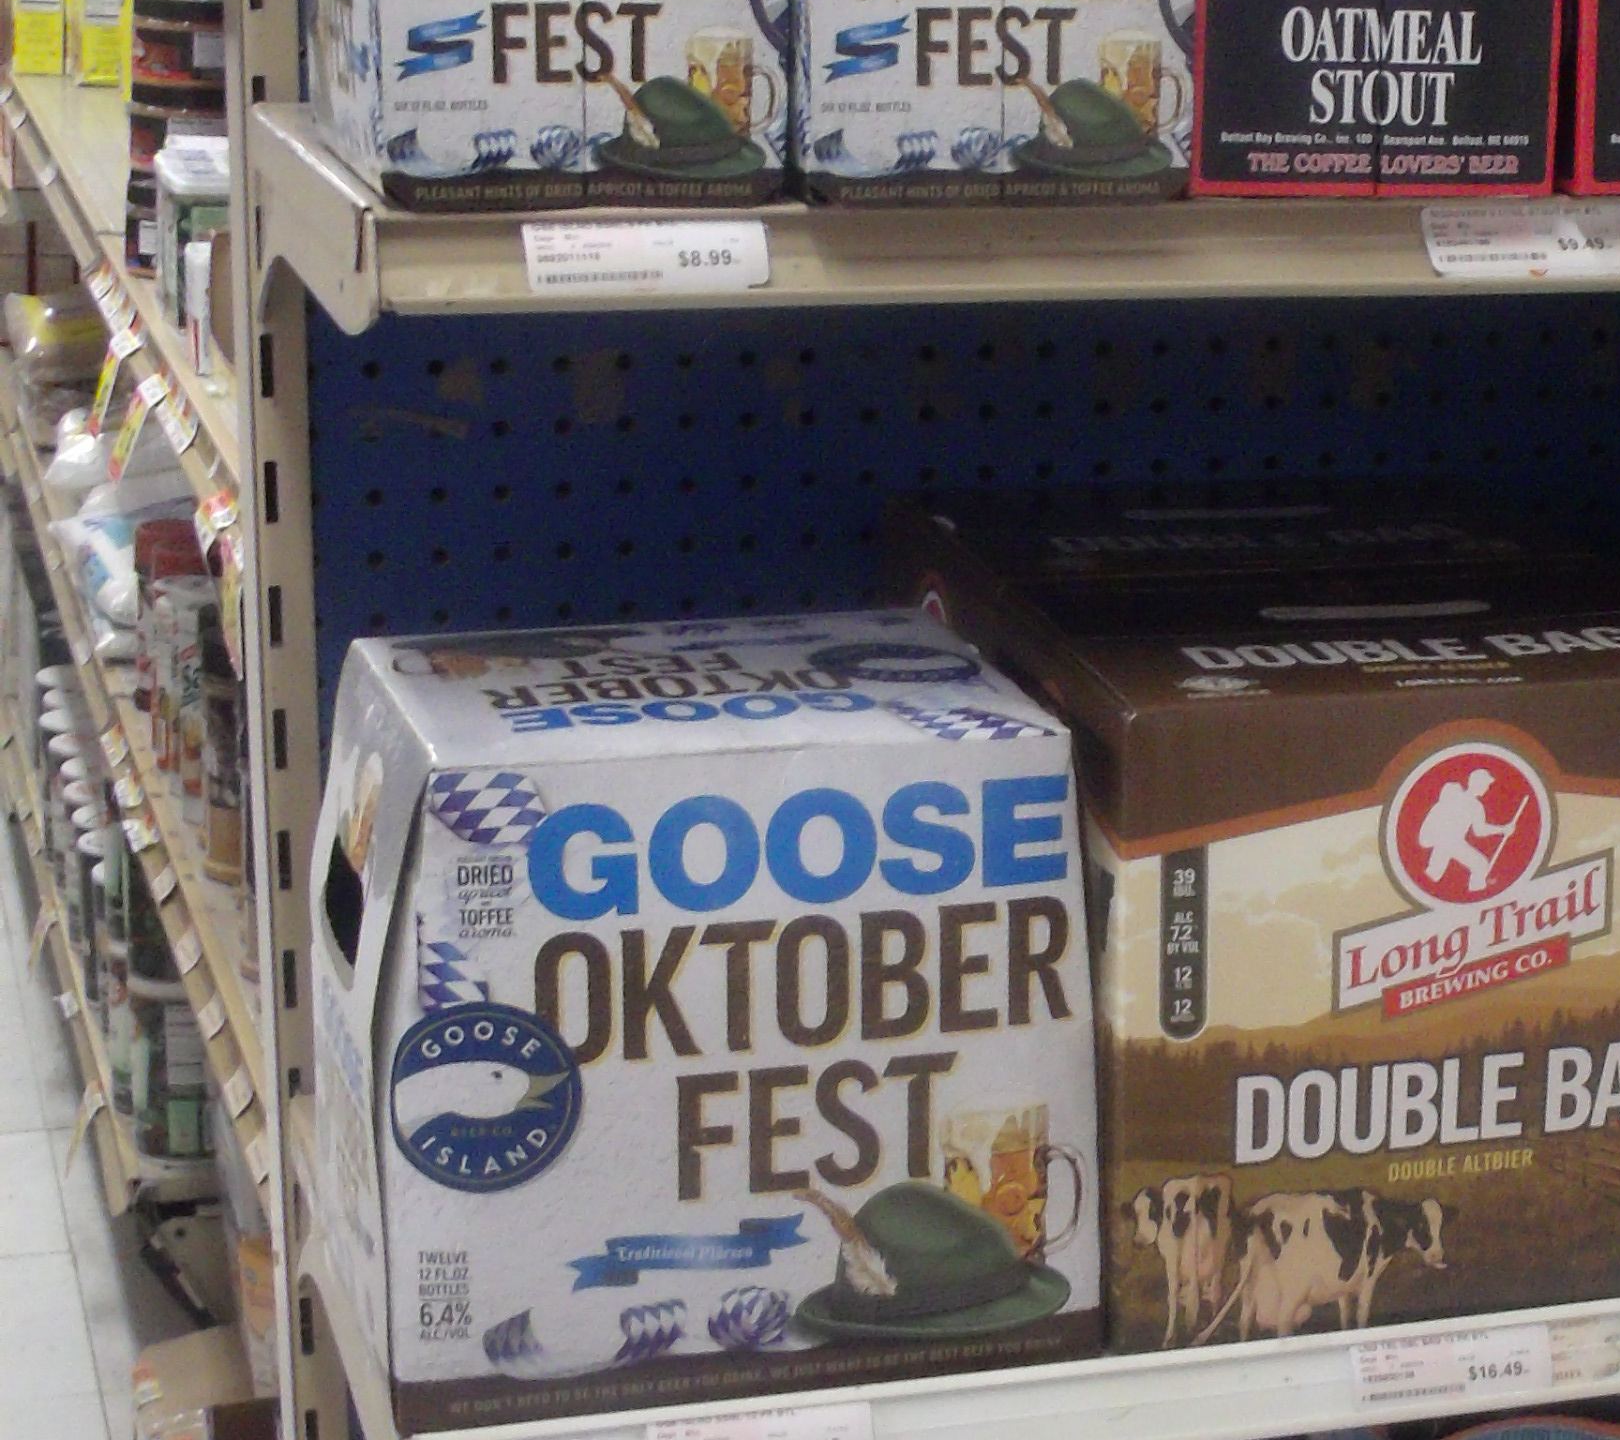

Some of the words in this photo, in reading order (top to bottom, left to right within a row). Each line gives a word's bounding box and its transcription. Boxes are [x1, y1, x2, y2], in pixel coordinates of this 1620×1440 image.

[492, 3, 663, 84] FEST
[914, 7, 1078, 87] FEST
[1281, 7, 1483, 65] OATMEAL
[1309, 70, 1455, 126] STOUT
[1248, 152, 1290, 172] THE
[1294, 153, 1372, 173] COFFEE
[1469, 155, 1519, 174] BEER
[678, 250, 733, 267] $8.99
[1181, 638, 1487, 670] DOUBLE
[528, 773, 1070, 921] GOOSE
[457, 865, 514, 887] DRIED
[1173, 868, 1196, 884] 39
[459, 908, 514, 926] TOFFEE
[1346, 924, 1468, 989] Long
[1480, 866, 1601, 947] Trail
[533, 895, 1073, 1066] OKTOBER
[1174, 966, 1192, 981] 12
[1399, 965, 1508, 1008] BREWING
[1174, 1000, 1192, 1014] 12
[420, 1022, 543, 1060] GOOSE
[677, 1050, 959, 1203] FEST
[1236, 1053, 1525, 1164] DOUBLE
[420, 1127, 550, 1175] ISLAND
[1388, 1156, 1457, 1182] DOUBLE
[1468, 1361, 1524, 1381] $16.49
